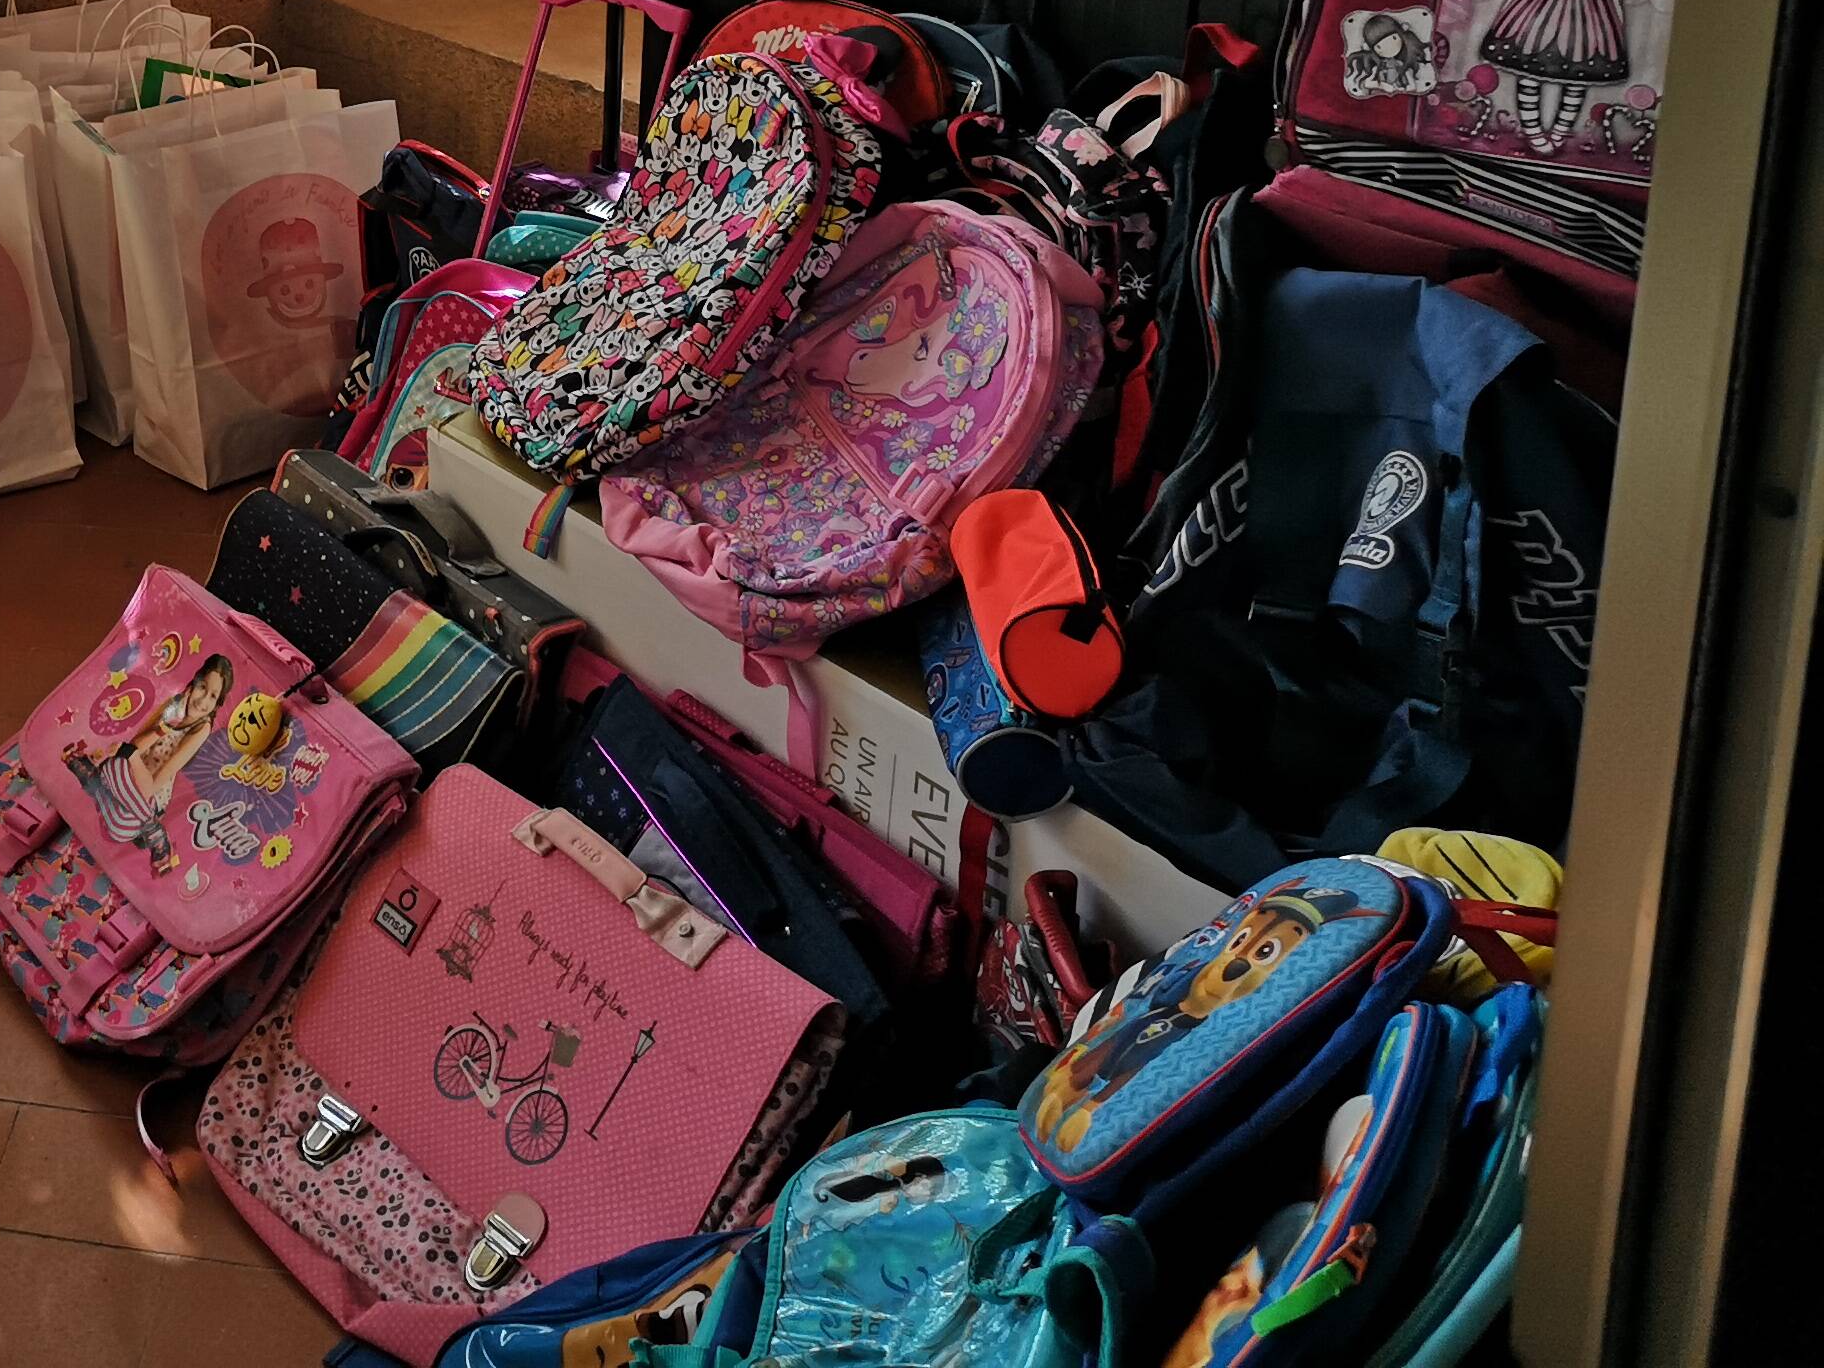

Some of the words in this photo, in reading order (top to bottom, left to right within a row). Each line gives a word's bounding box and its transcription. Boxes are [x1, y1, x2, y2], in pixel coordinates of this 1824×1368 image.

[829, 717, 850, 761] AU
[857, 735, 878, 778] UN
[853, 777, 874, 826] AIR
